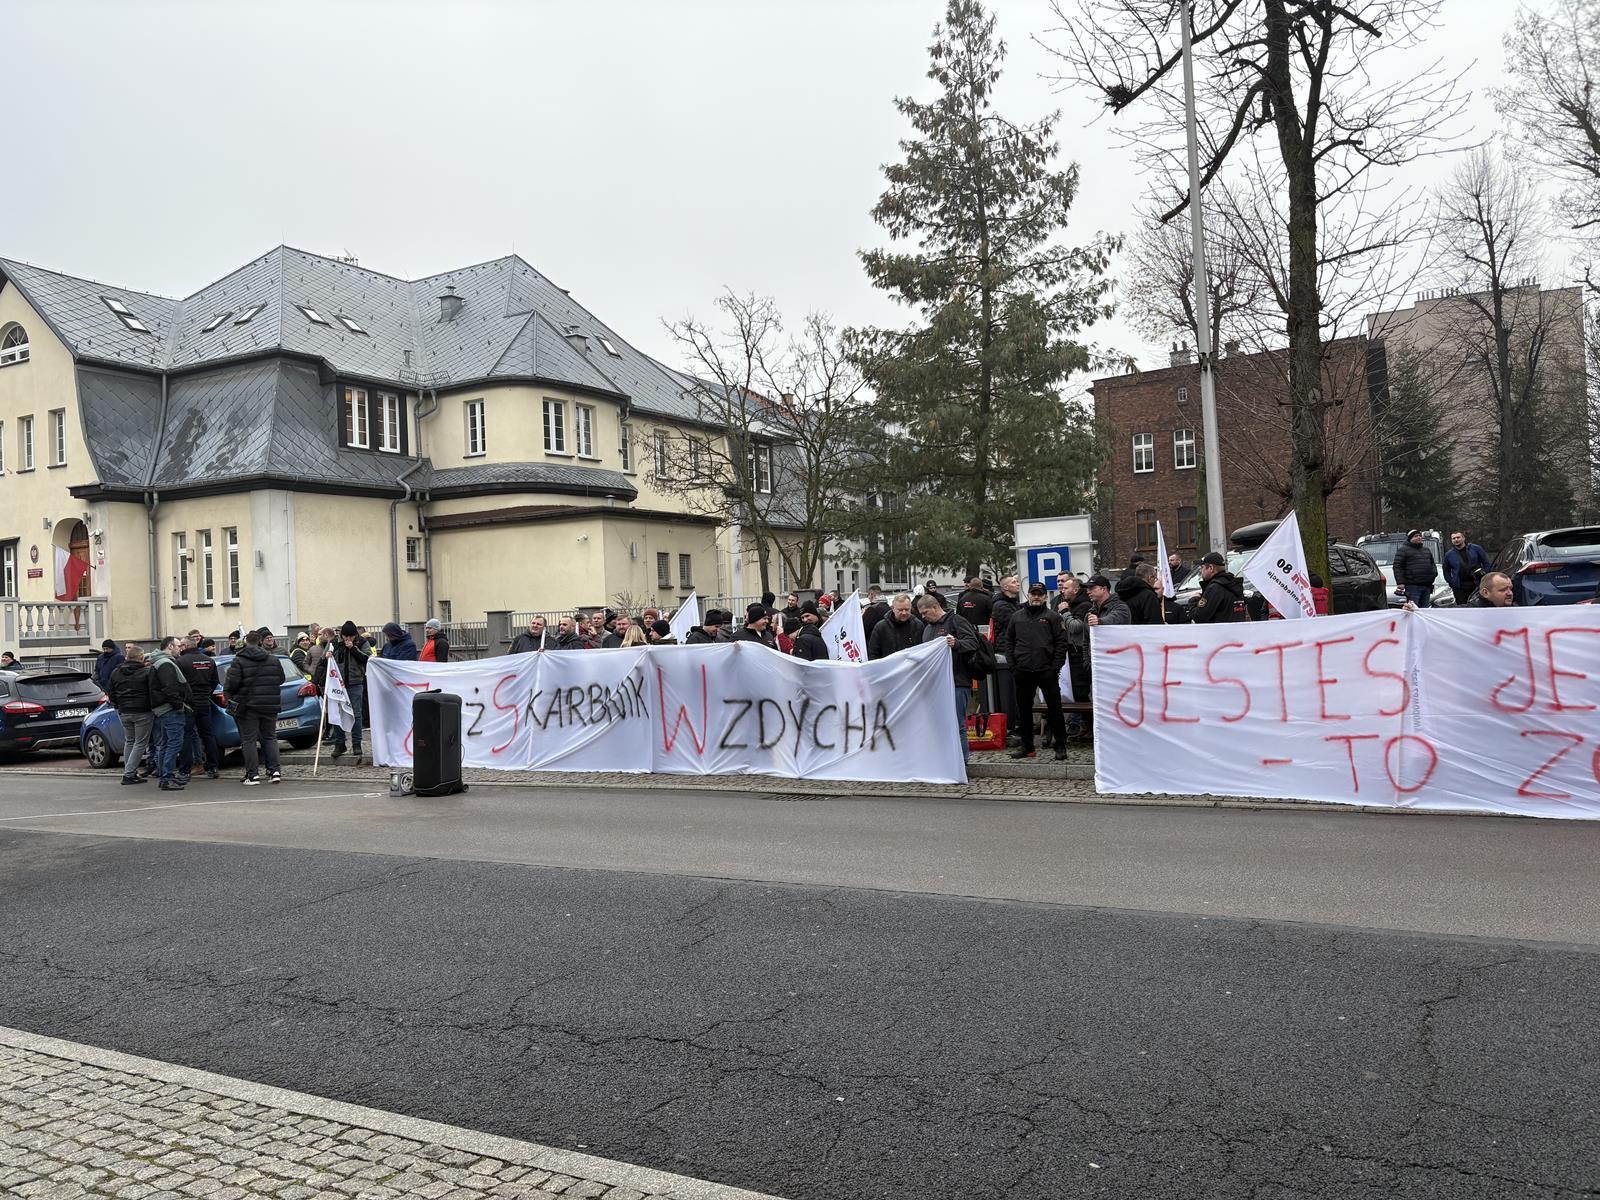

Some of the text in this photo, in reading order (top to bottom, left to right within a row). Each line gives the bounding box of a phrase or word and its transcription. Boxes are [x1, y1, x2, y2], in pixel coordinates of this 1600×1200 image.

[1037, 551, 1062, 590] P
[1105, 620, 1410, 728] JESTEŚ
[395, 680, 486, 757] JŻ
[491, 673, 650, 754] SKARBNIK
[1324, 734, 1438, 793] TO
[1518, 730, 1600, 798] Z
